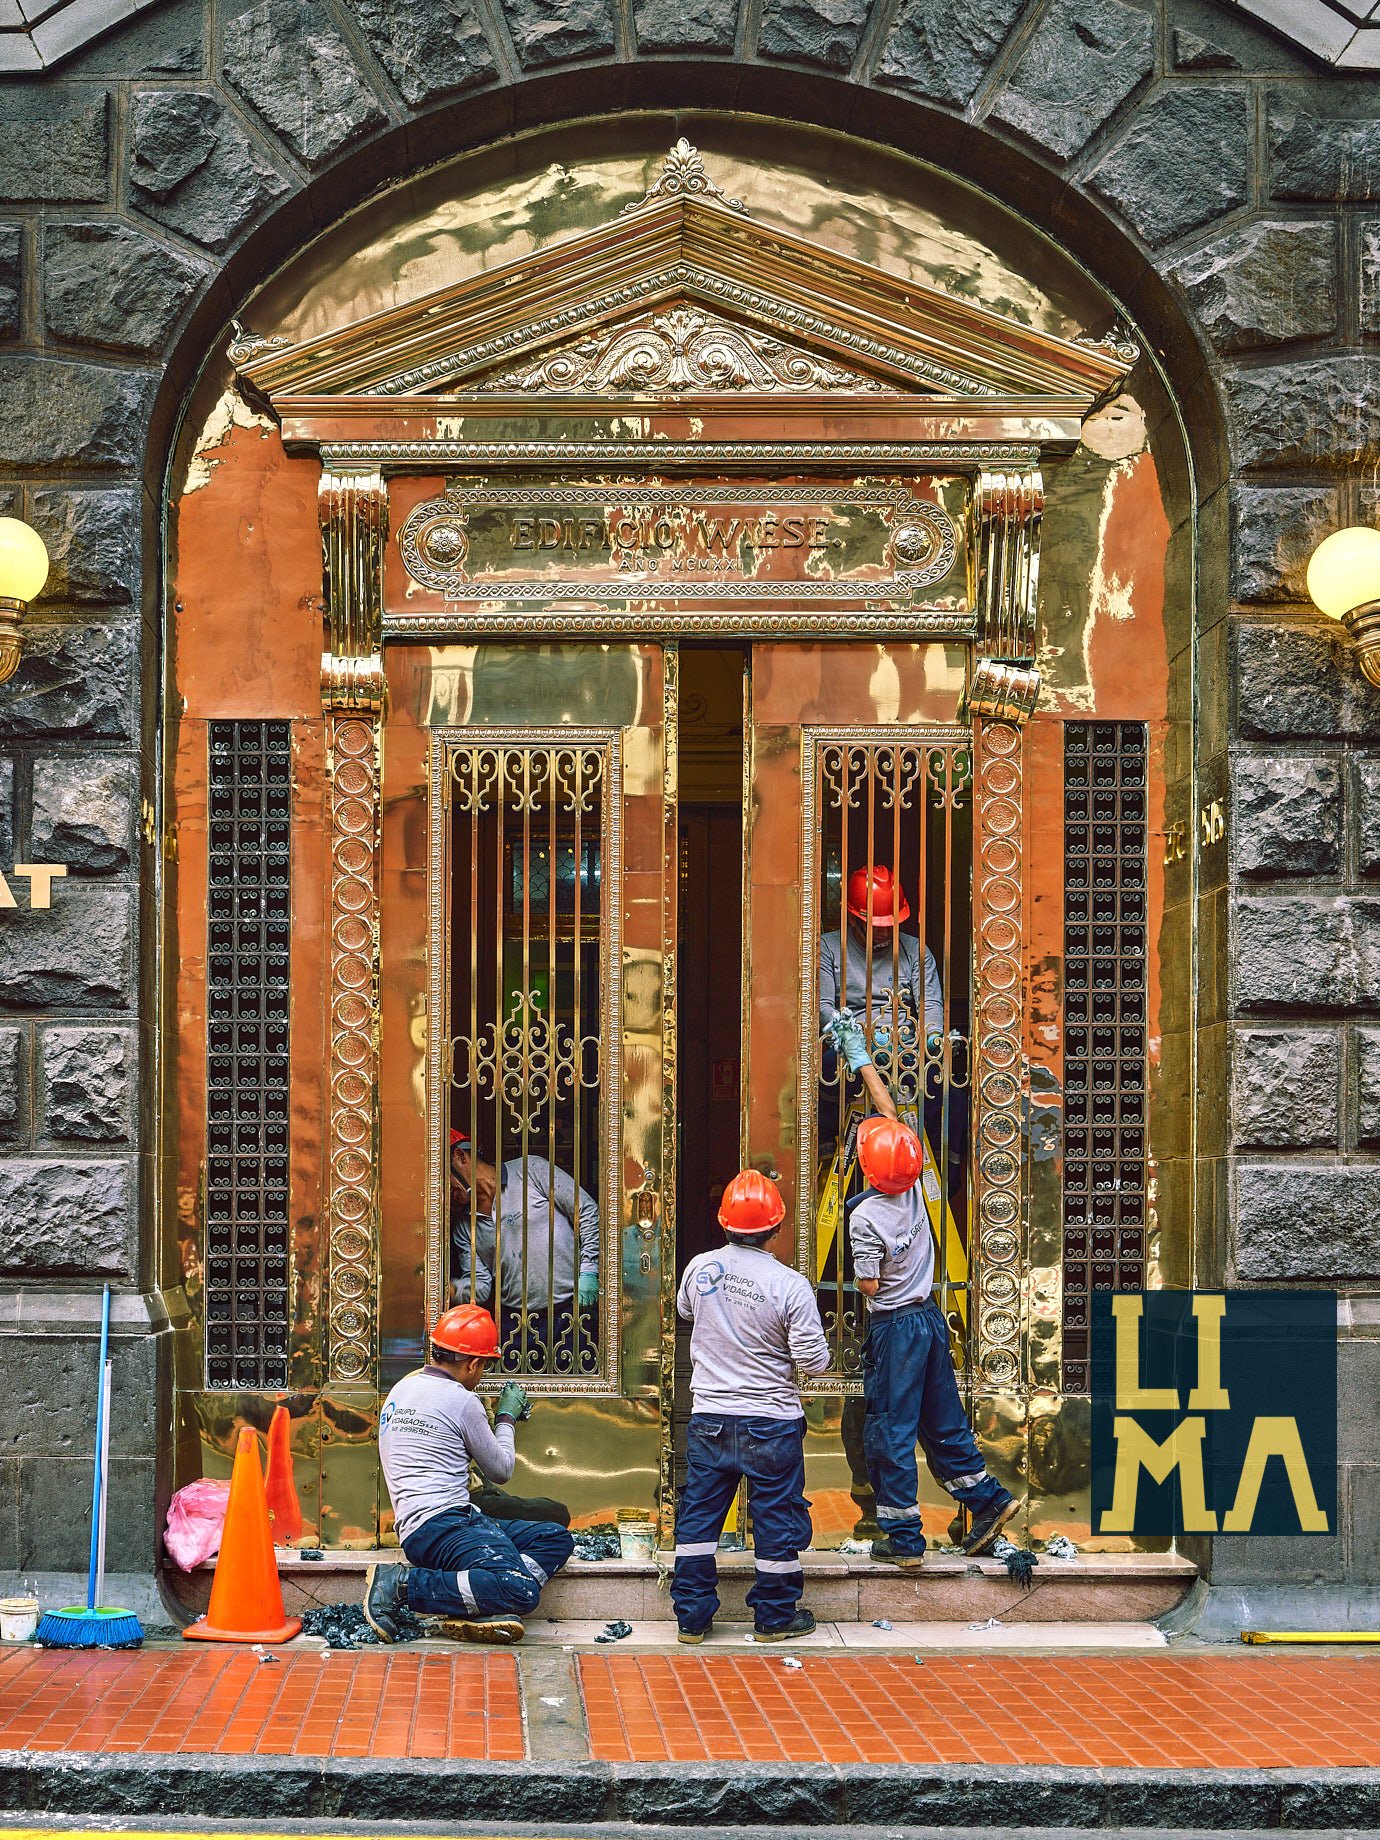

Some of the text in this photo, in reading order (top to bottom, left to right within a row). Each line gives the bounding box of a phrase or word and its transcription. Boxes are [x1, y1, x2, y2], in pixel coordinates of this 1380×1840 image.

[512, 517, 676, 550] EDIFICIO
[671, 557, 742, 572] MCMXXI
[724, 1273, 755, 1288] GRUPO
